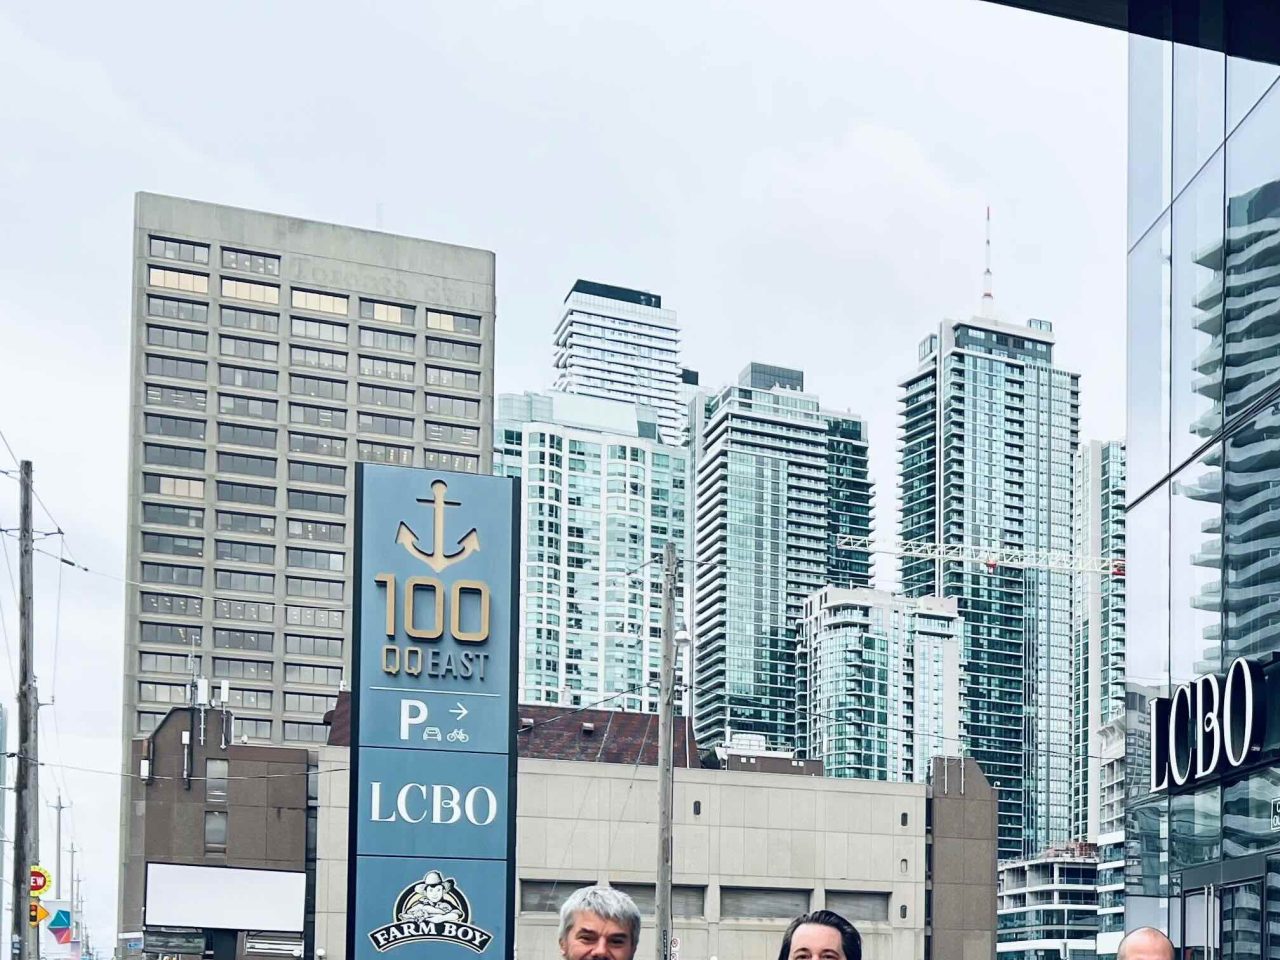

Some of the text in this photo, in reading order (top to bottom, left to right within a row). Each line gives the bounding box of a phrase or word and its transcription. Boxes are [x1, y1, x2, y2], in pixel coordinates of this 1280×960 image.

[374, 572, 491, 642] 100
[400, 699, 428, 740] P
[1149, 656, 1253, 793] LCBO
[369, 782, 498, 826] LCBO
[31, 876, 44, 886] EW
[374, 922, 489, 947] FARM BOY
